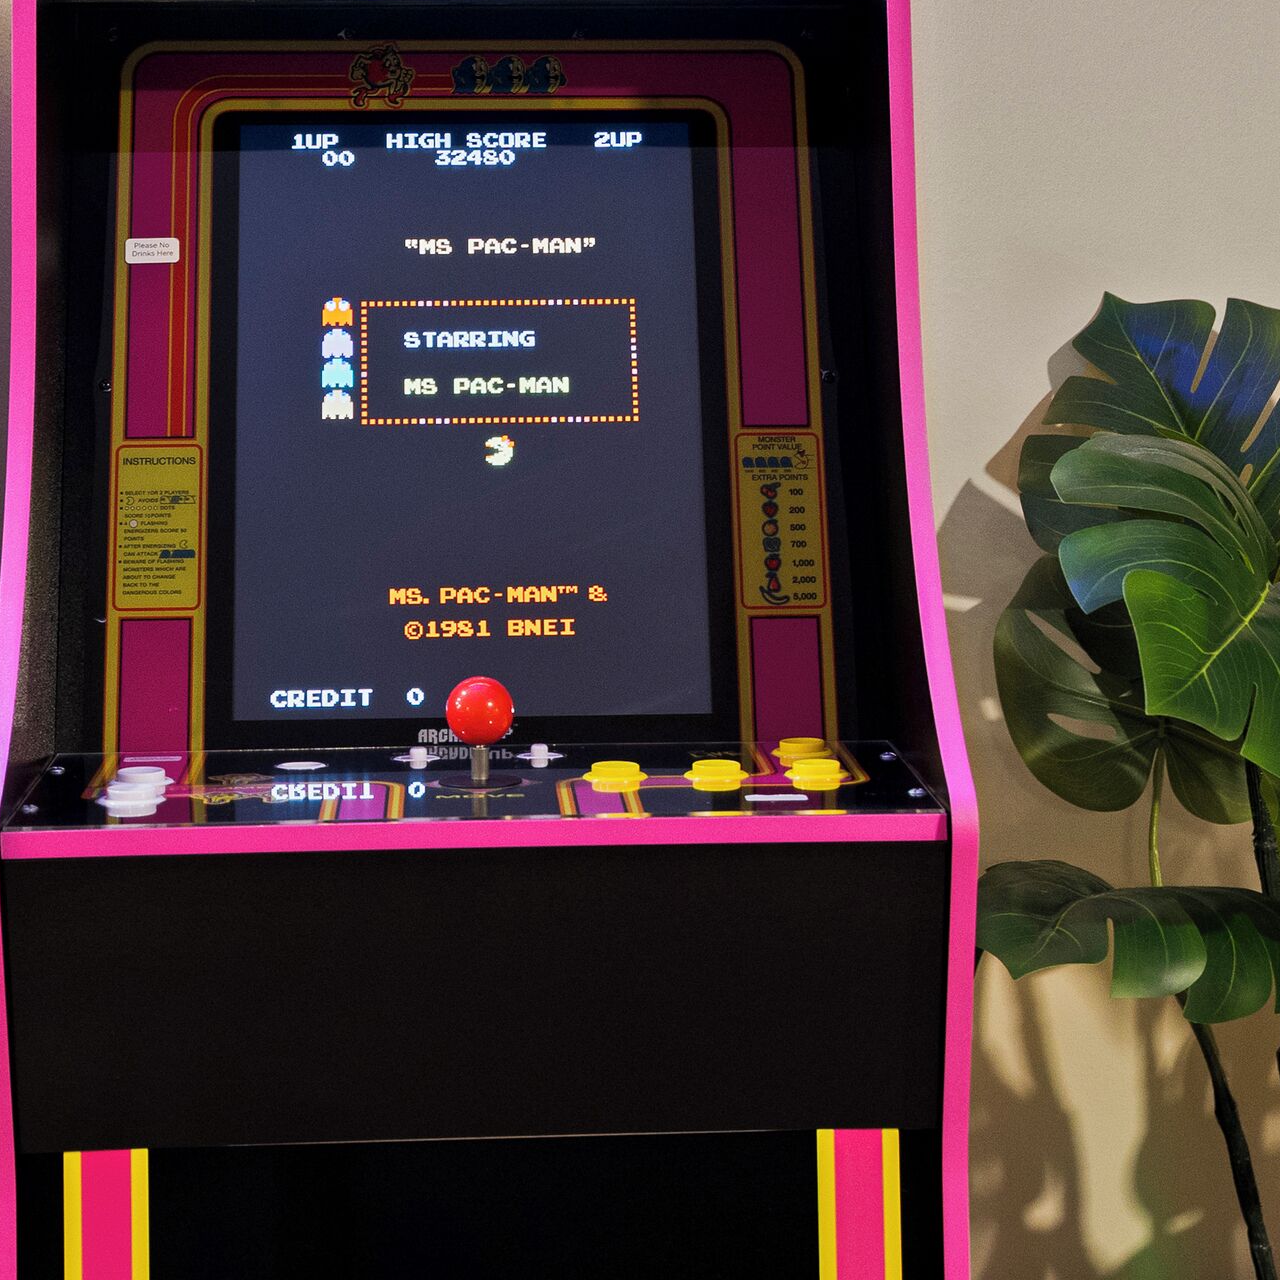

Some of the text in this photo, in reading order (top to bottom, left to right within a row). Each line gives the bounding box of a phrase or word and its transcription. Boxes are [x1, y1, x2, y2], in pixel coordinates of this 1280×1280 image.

[291, 131, 643, 150] 1UP HIGH SCORE 2UP
[322, 149, 516, 167] 00 32480
[403, 330, 536, 349] STARRING
[403, 376, 570, 396] MS PAC-MAN
[122, 456, 197, 466] INSTRUCTIONS
[751, 473, 809, 481] EXTRA POINTS
[788, 488, 803, 496] 100
[788, 506, 805, 514] 200
[789, 523, 806, 531] 500
[790, 540, 807, 548] 700
[791, 559, 815, 568] 1,000
[792, 576, 817, 585] 2,000
[388, 587, 430, 605] MS.
[587, 584, 608, 602] &
[793, 592, 817, 600] 5,000
[404, 618, 576, 640] ©1981 BNEI
[269, 687, 425, 708] CREDIT 0
